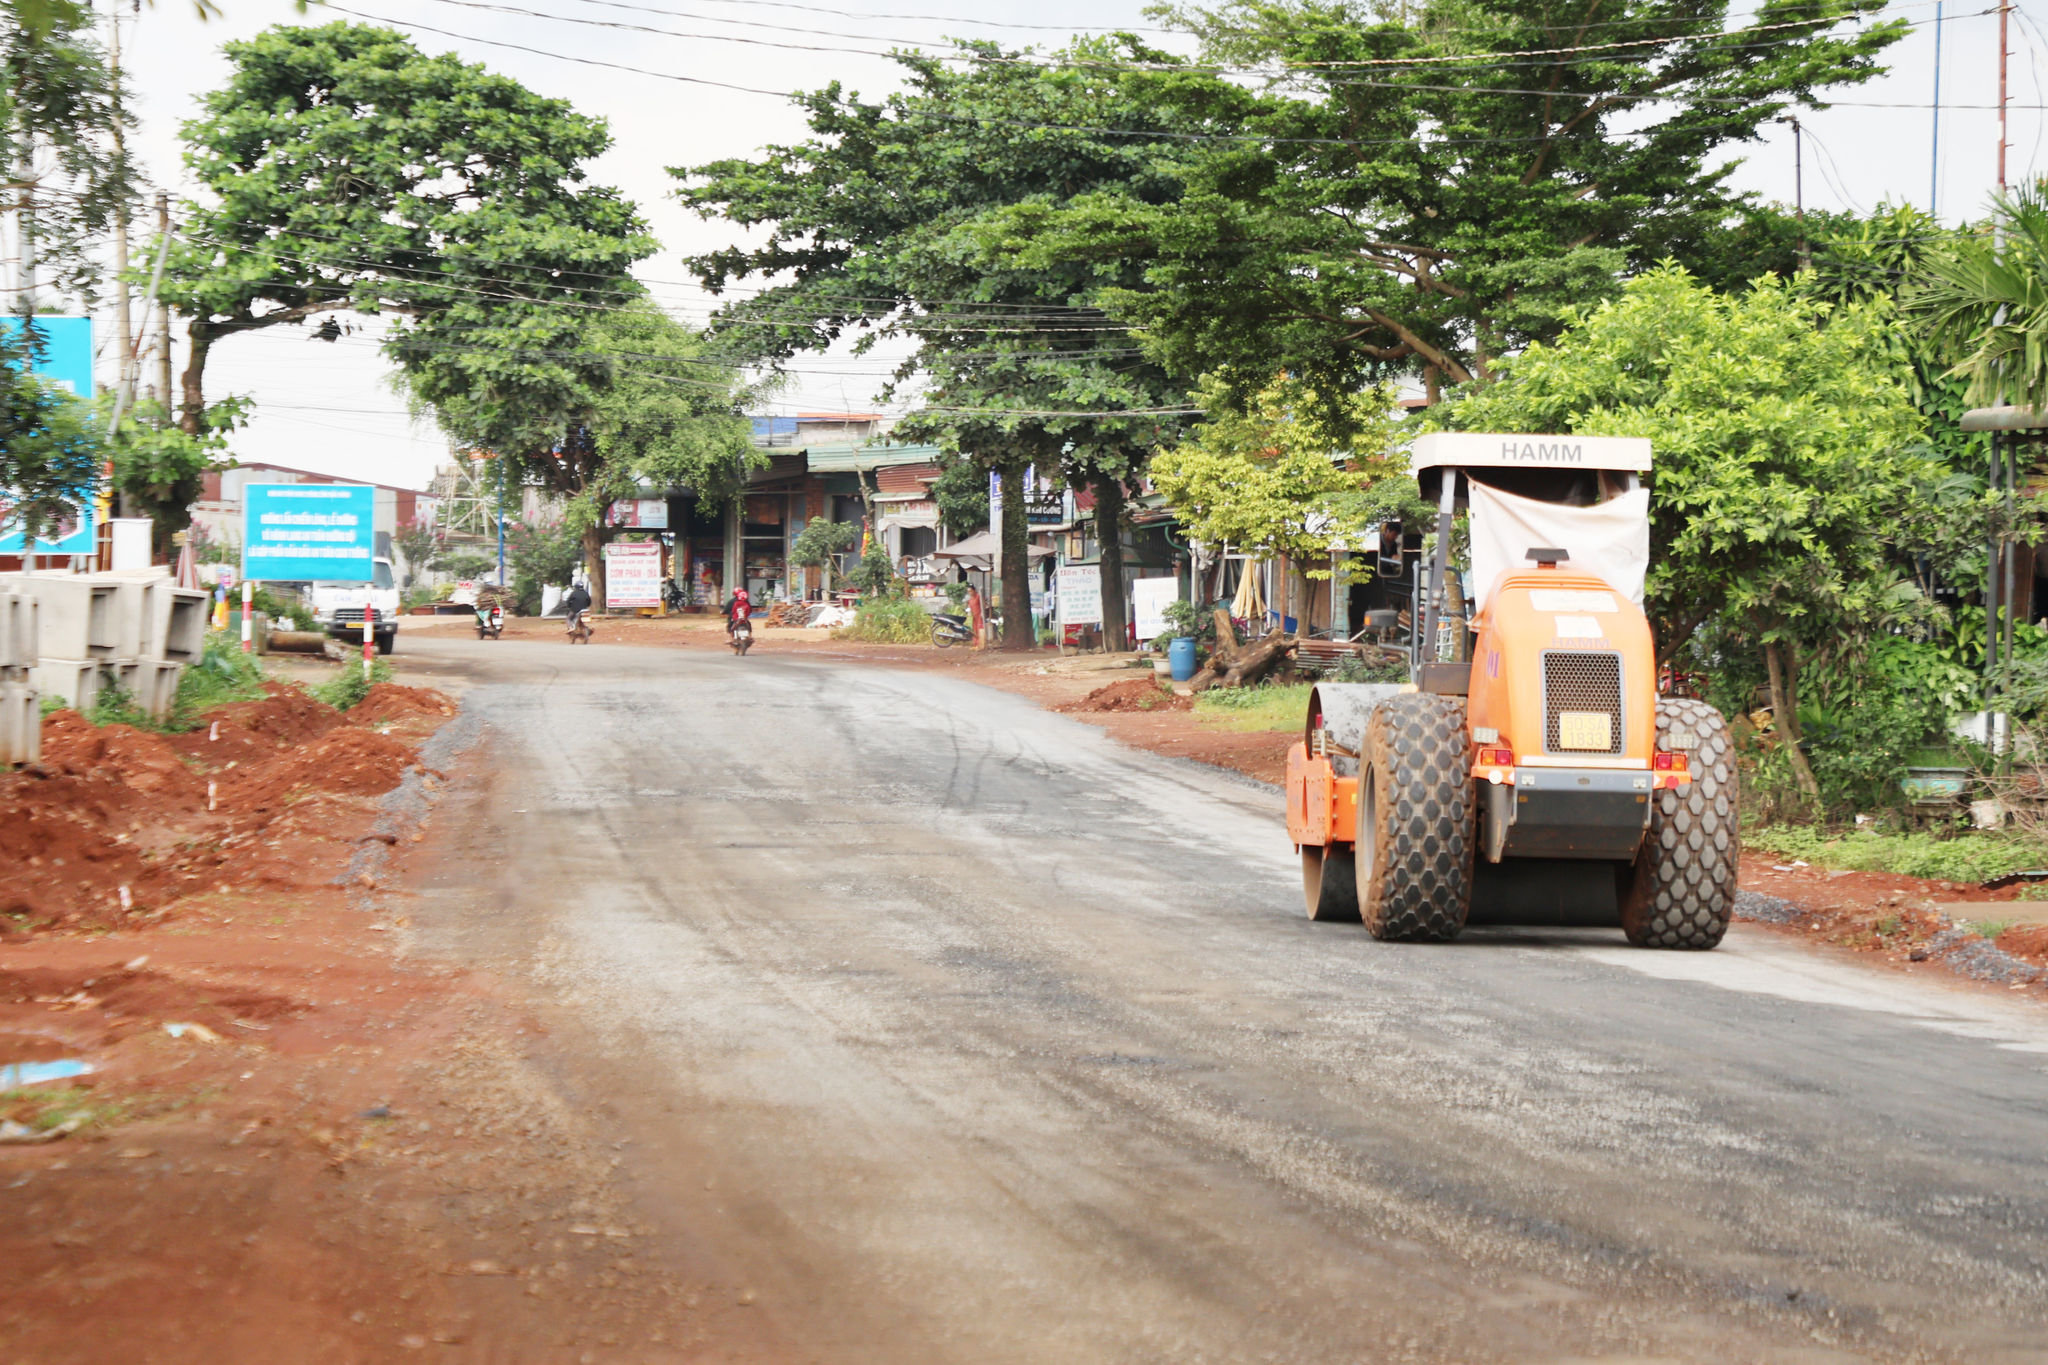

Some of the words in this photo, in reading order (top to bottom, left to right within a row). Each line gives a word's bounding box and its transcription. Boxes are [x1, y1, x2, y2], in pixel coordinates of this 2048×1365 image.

[1501, 442, 1582, 462] HAMM
[1551, 638, 1611, 649] HAMM
[1570, 733, 1604, 747] 1833
